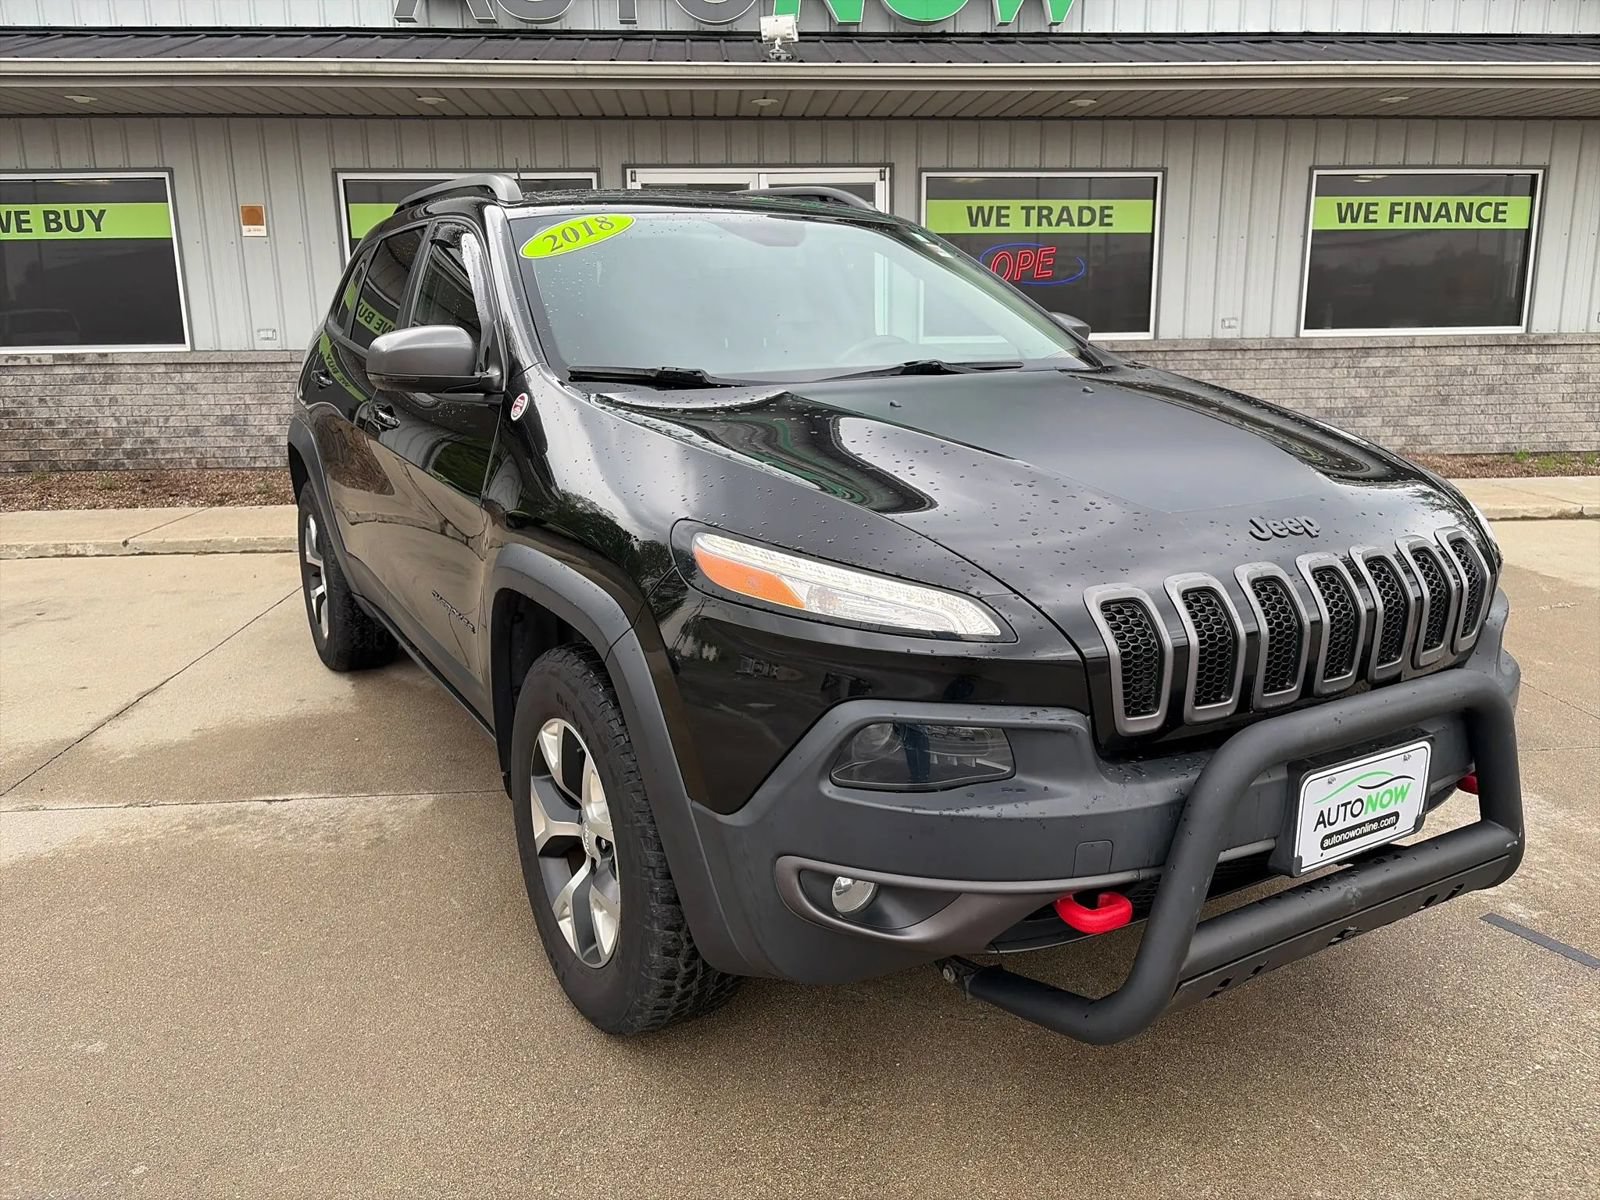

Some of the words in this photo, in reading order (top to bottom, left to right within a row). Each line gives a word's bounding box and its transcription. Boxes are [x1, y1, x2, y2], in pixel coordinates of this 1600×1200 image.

[43, 209, 107, 232] BUY
[966, 205, 1011, 228] WE
[1020, 205, 1114, 227] TRADE
[1336, 202, 1380, 224] WE
[1388, 201, 1508, 223] FINANCE
[542, 216, 615, 253] 2018
[1248, 516, 1321, 542] Jeep
[1313, 783, 1411, 832] AUTONOW
[1322, 816, 1396, 848] autonowonline.com
